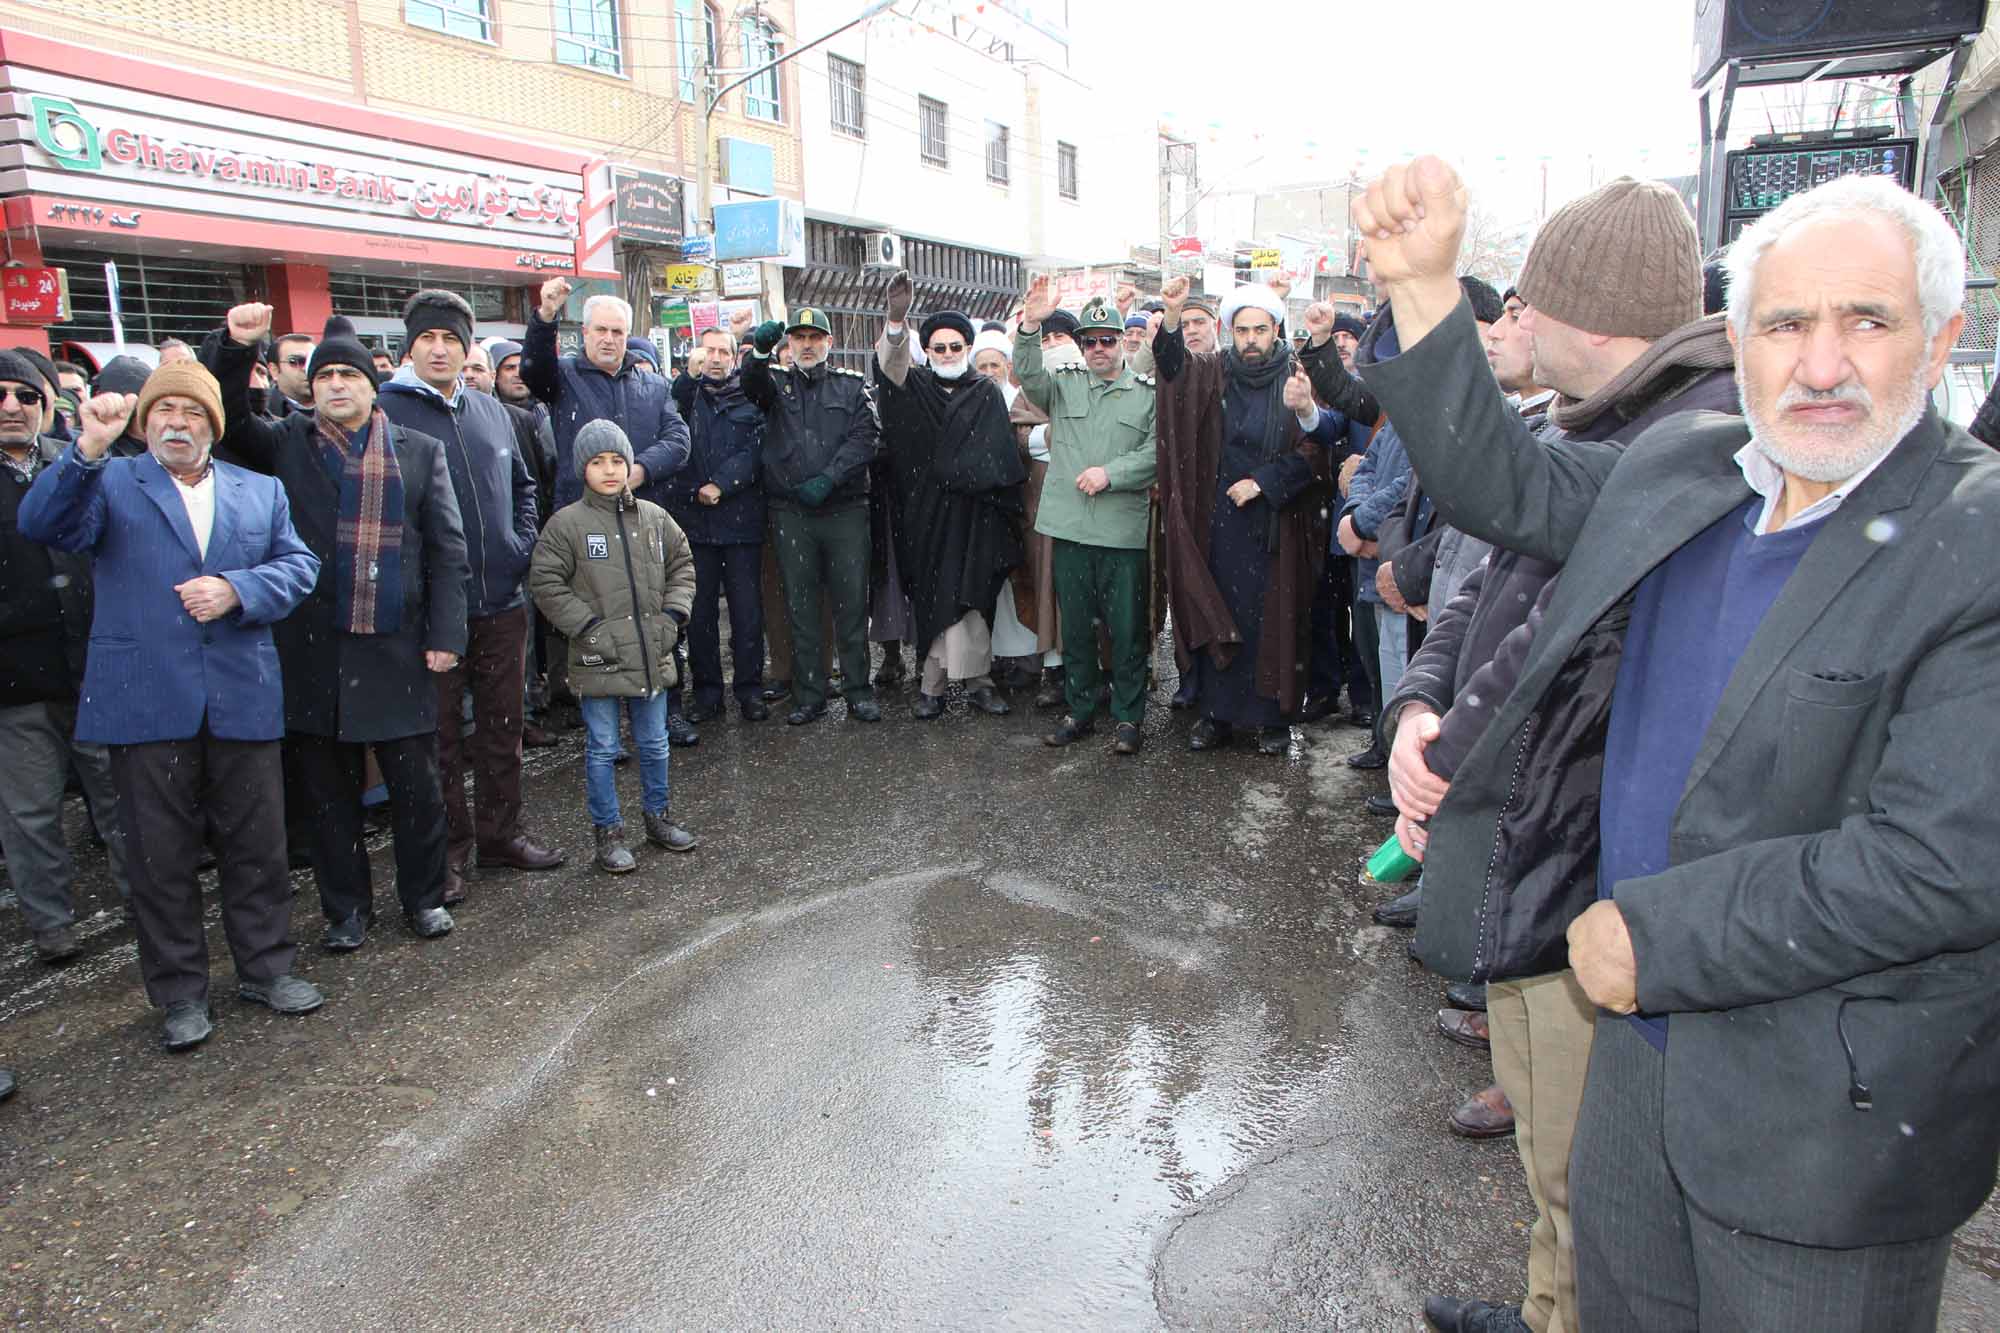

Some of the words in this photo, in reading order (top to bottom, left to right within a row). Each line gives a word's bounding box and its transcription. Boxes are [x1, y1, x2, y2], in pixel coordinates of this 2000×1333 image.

[106, 128, 309, 192] Ghavamin
[315, 162, 399, 203] Bank
[414, 174, 510, 227] قوامین
[516, 186, 580, 239] بانک
[39, 279, 54, 294] 24
[590, 543, 606, 555] 79
